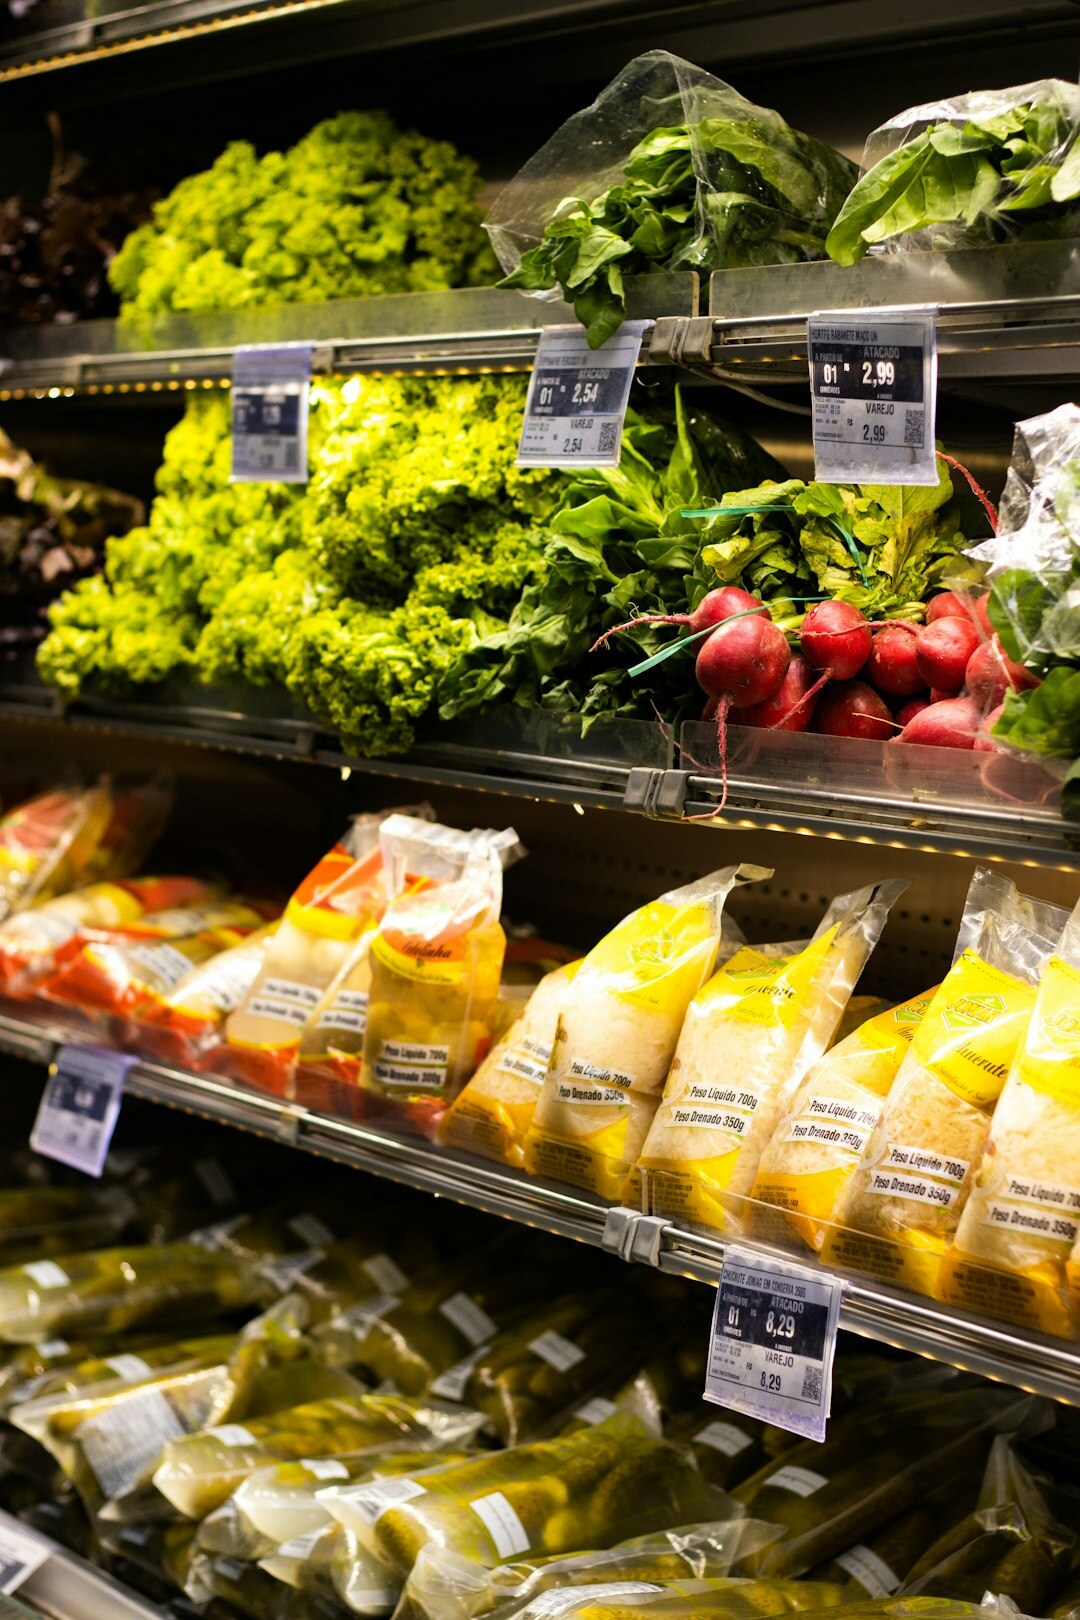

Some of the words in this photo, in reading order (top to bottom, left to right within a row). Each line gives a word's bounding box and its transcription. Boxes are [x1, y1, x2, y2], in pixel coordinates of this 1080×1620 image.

[831, 329, 855, 341] RABANETE
[863, 346, 900, 359] ATACADO
[577, 369, 610, 379] ATACADO
[823, 363, 838, 384] 01
[862, 361, 895, 388] 2,99
[540, 387, 553, 405] 01
[571, 382, 600, 406] 2,54
[865, 402, 895, 416] VAREJO
[570, 418, 594, 429] VAREJO
[863, 424, 885, 444] 2,99
[562, 438, 583, 454] 2,54
[570, 1062, 584, 1075] Peso
[584, 1064, 611, 1082] Líquido
[559, 1085, 571, 1098] Peso
[572, 1086, 602, 1101] Drenado
[604, 1088, 625, 1102] 350g
[690, 1086, 708, 1098] Peso
[708, 1087, 737, 1102] Líquido
[737, 1092, 758, 1110] 700g
[810, 1100, 828, 1113] Peso
[827, 1102, 858, 1120] Líquido
[674, 1110, 690, 1122] Peso
[690, 1110, 722, 1125] Drenado
[722, 1115, 745, 1133] 350g
[792, 1124, 808, 1137] Peso
[808, 1125, 841, 1142] Drenado
[841, 1131, 863, 1150] 350g
[890, 1148, 909, 1164] Peso
[909, 1152, 942, 1171] Líquido
[943, 1160, 966, 1181] 700g
[873, 1175, 890, 1189] Peso
[890, 1177, 927, 1196] Drenado
[927, 1186, 951, 1205] 350g
[1008, 1179, 1030, 1196] Peso
[1030, 1183, 1065, 1204] Líquido
[990, 1206, 1010, 1222] Peso
[1010, 1210, 1050, 1231] Drenado
[763, 1278, 771, 1290] EM
[769, 1295, 804, 1314] ATACADO
[728, 1305, 740, 1327] 01
[765, 1310, 796, 1339] 8,29
[764, 1350, 794, 1368] VAREJO
[760, 1371, 782, 1392] 8,29
